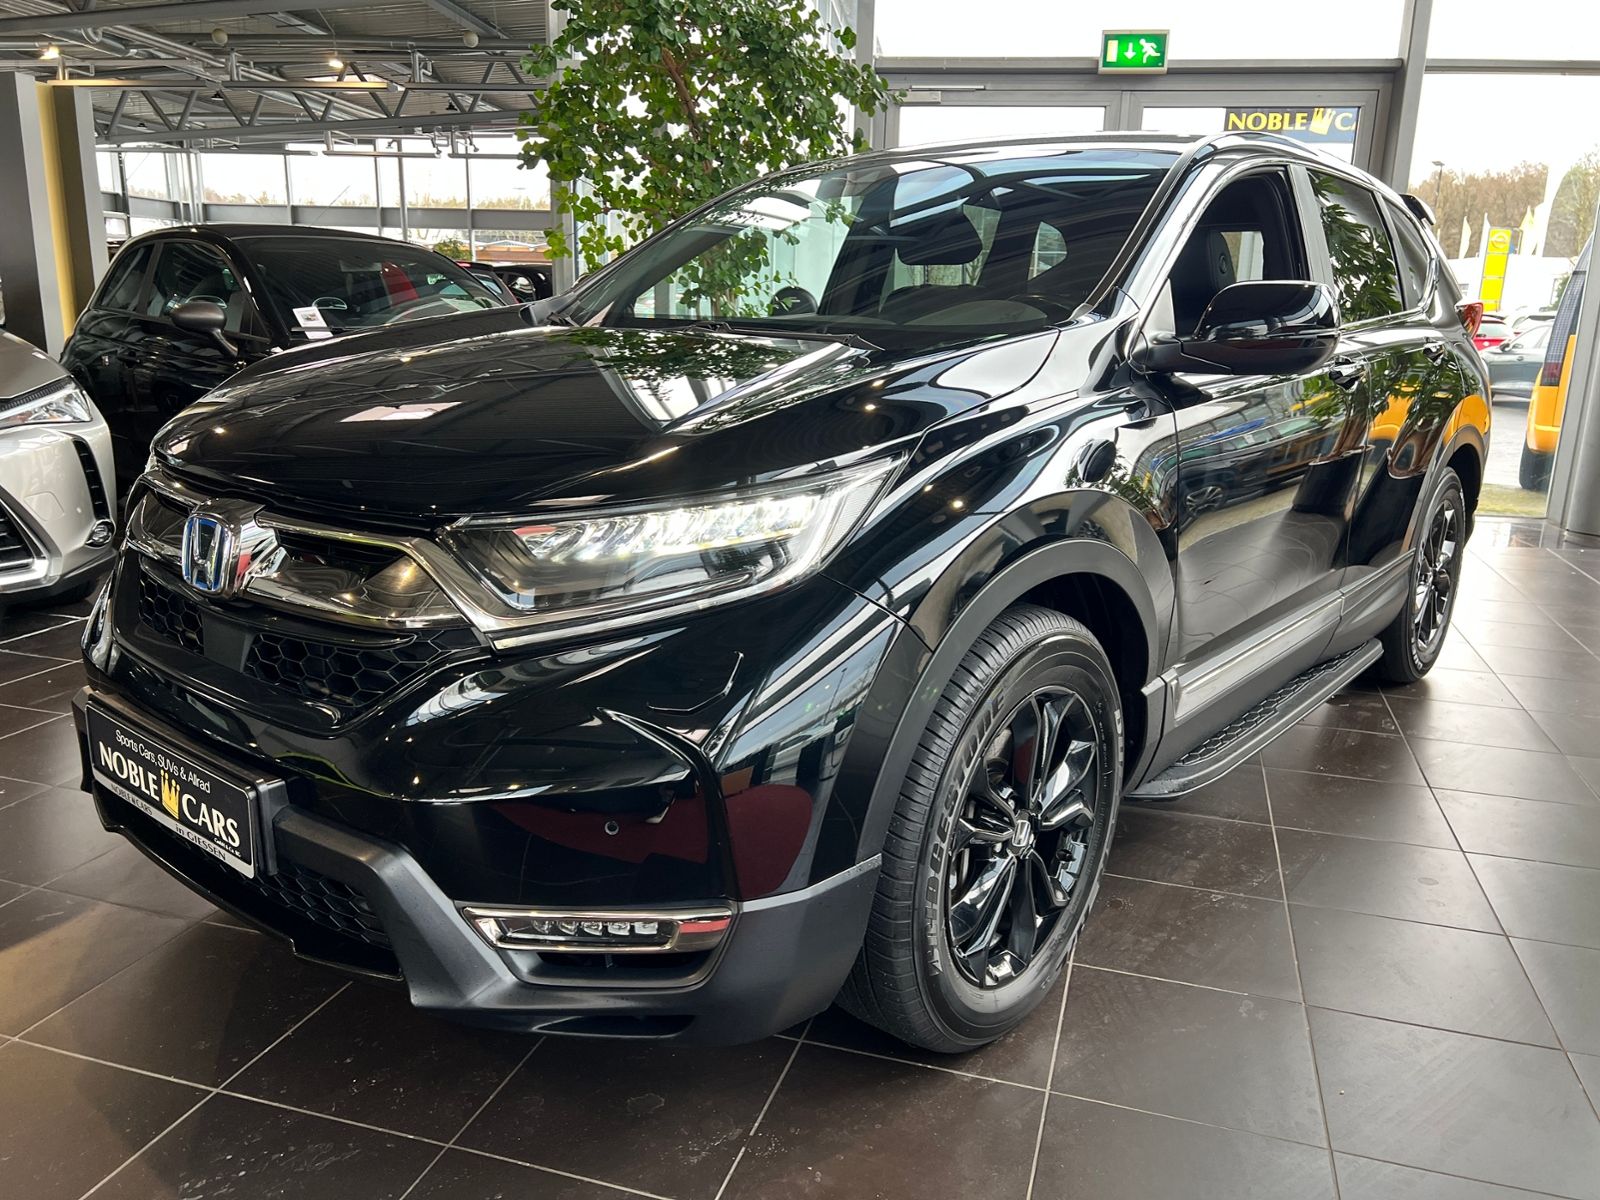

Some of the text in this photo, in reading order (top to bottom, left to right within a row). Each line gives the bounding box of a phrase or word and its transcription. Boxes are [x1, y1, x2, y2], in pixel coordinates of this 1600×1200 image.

[1228, 112, 1356, 131] NOBLE C
[115, 729, 211, 794] Sports Cars, SUVs & Allrad
[98, 741, 241, 848] NOBLE CARS
[175, 823, 185, 836] in
[186, 831, 227, 861] GIESSEN
